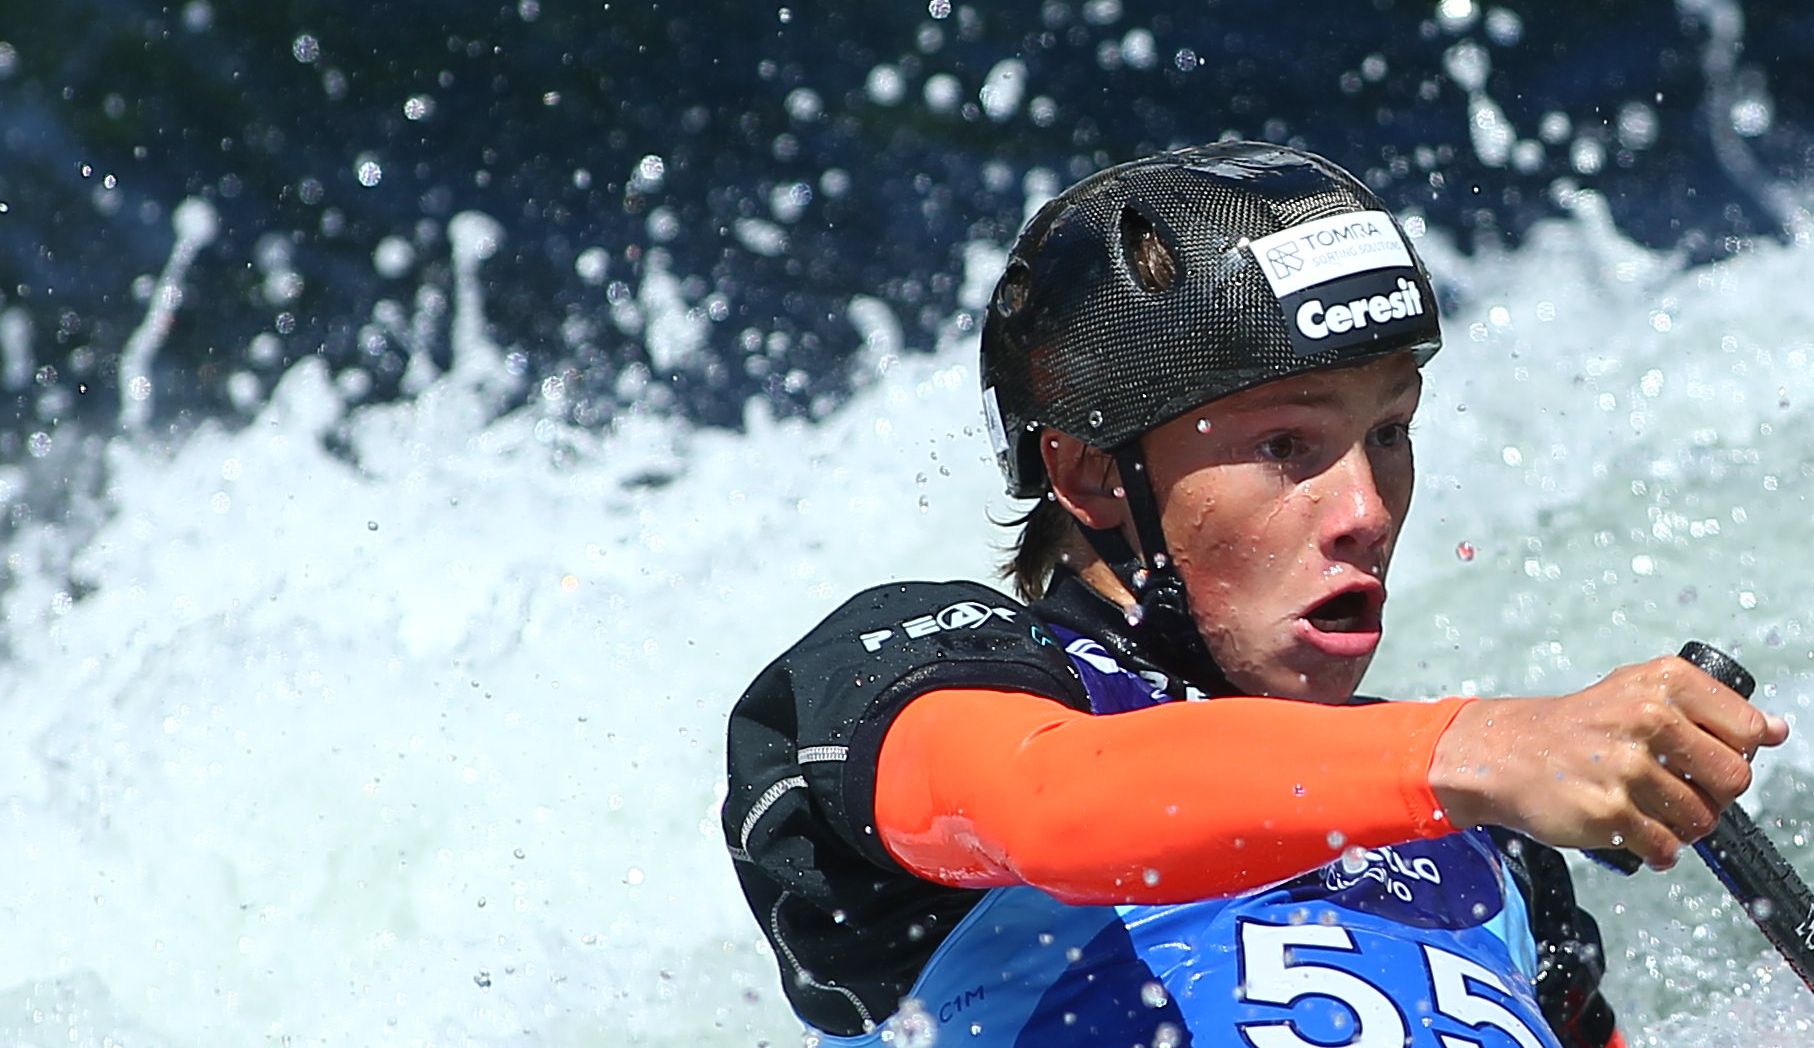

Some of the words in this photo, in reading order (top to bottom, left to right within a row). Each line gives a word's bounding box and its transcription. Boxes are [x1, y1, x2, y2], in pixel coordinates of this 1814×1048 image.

[1300, 222, 1382, 249] TOMRA
[1312, 247, 1358, 267] SORTING
[1296, 277, 1424, 340] Ceresit
[939, 985, 985, 1024] C1M
